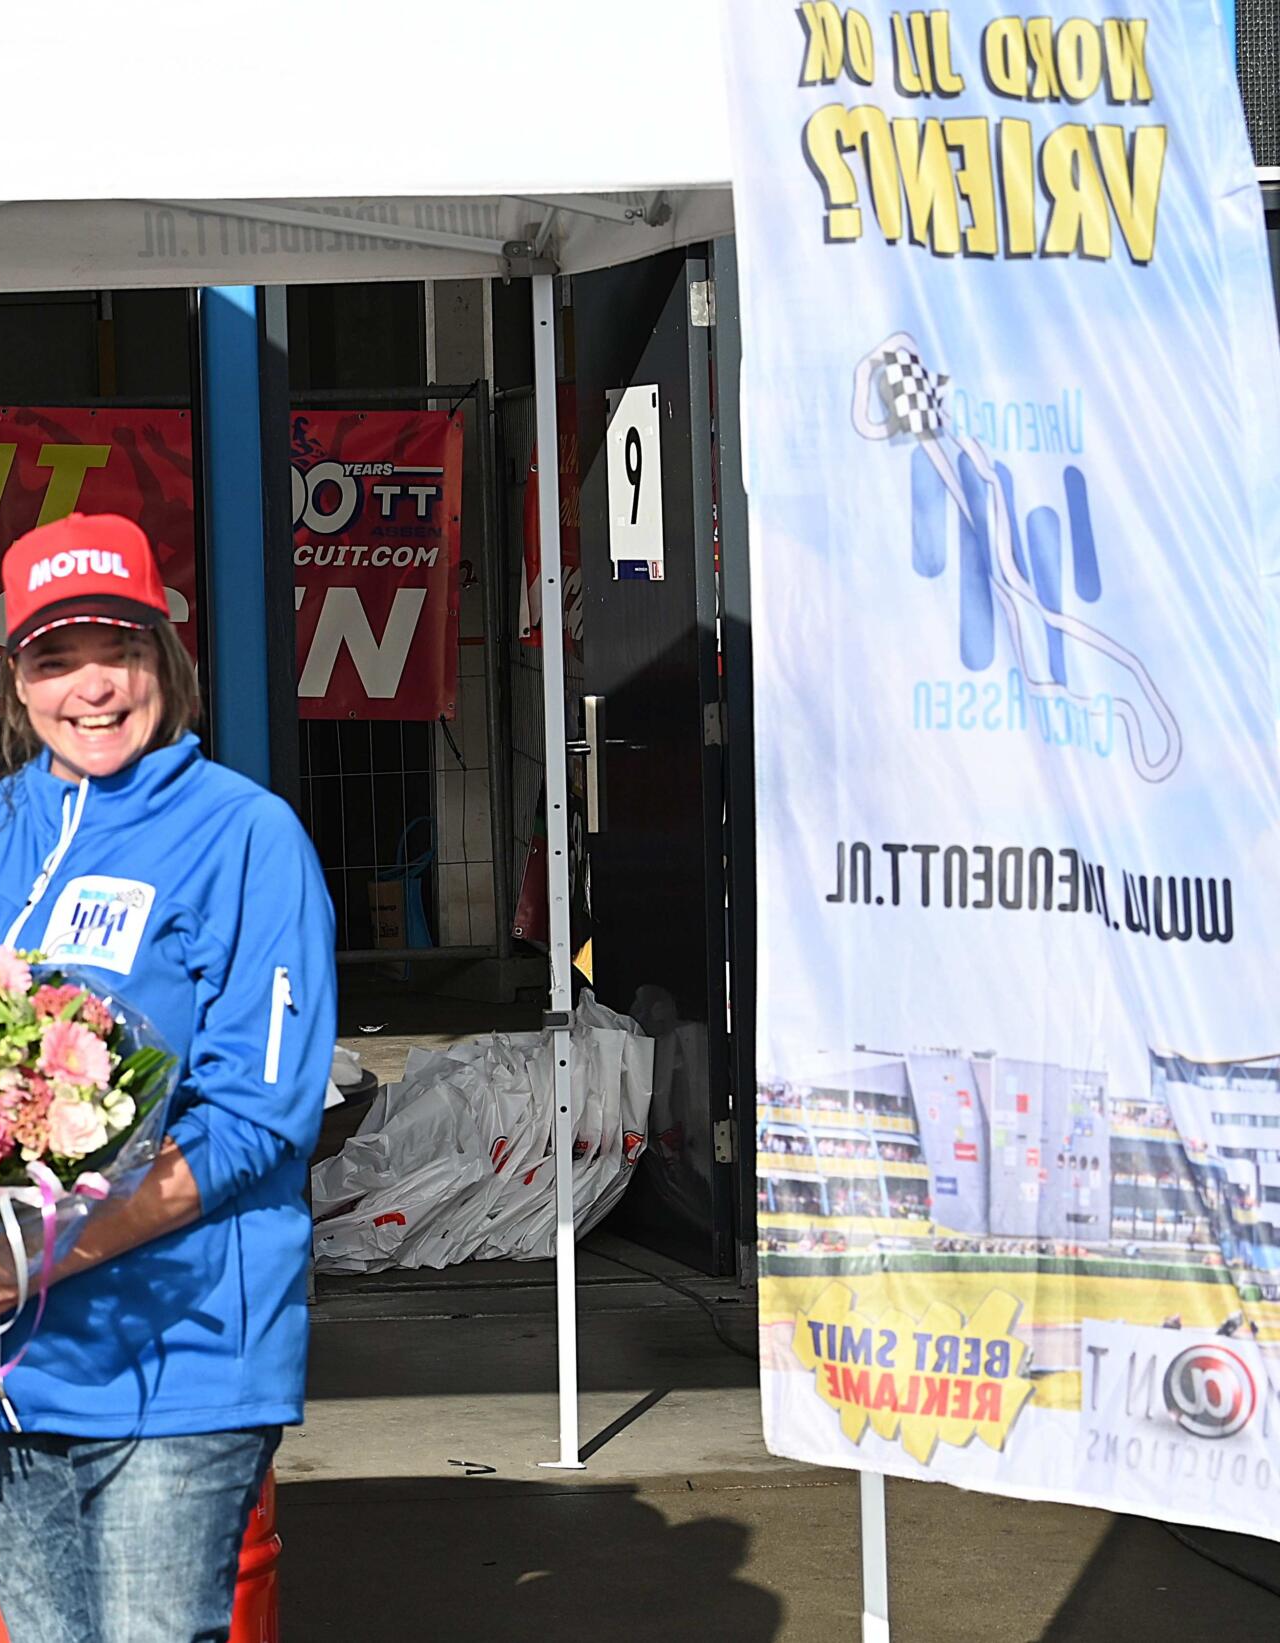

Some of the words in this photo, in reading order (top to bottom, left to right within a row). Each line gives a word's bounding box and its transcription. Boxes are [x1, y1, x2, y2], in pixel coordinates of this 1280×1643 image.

[343, 463, 394, 477] YEARS
[624, 426, 643, 525] 9
[373, 485, 438, 518] TT
[28, 549, 130, 592] MOTUL
